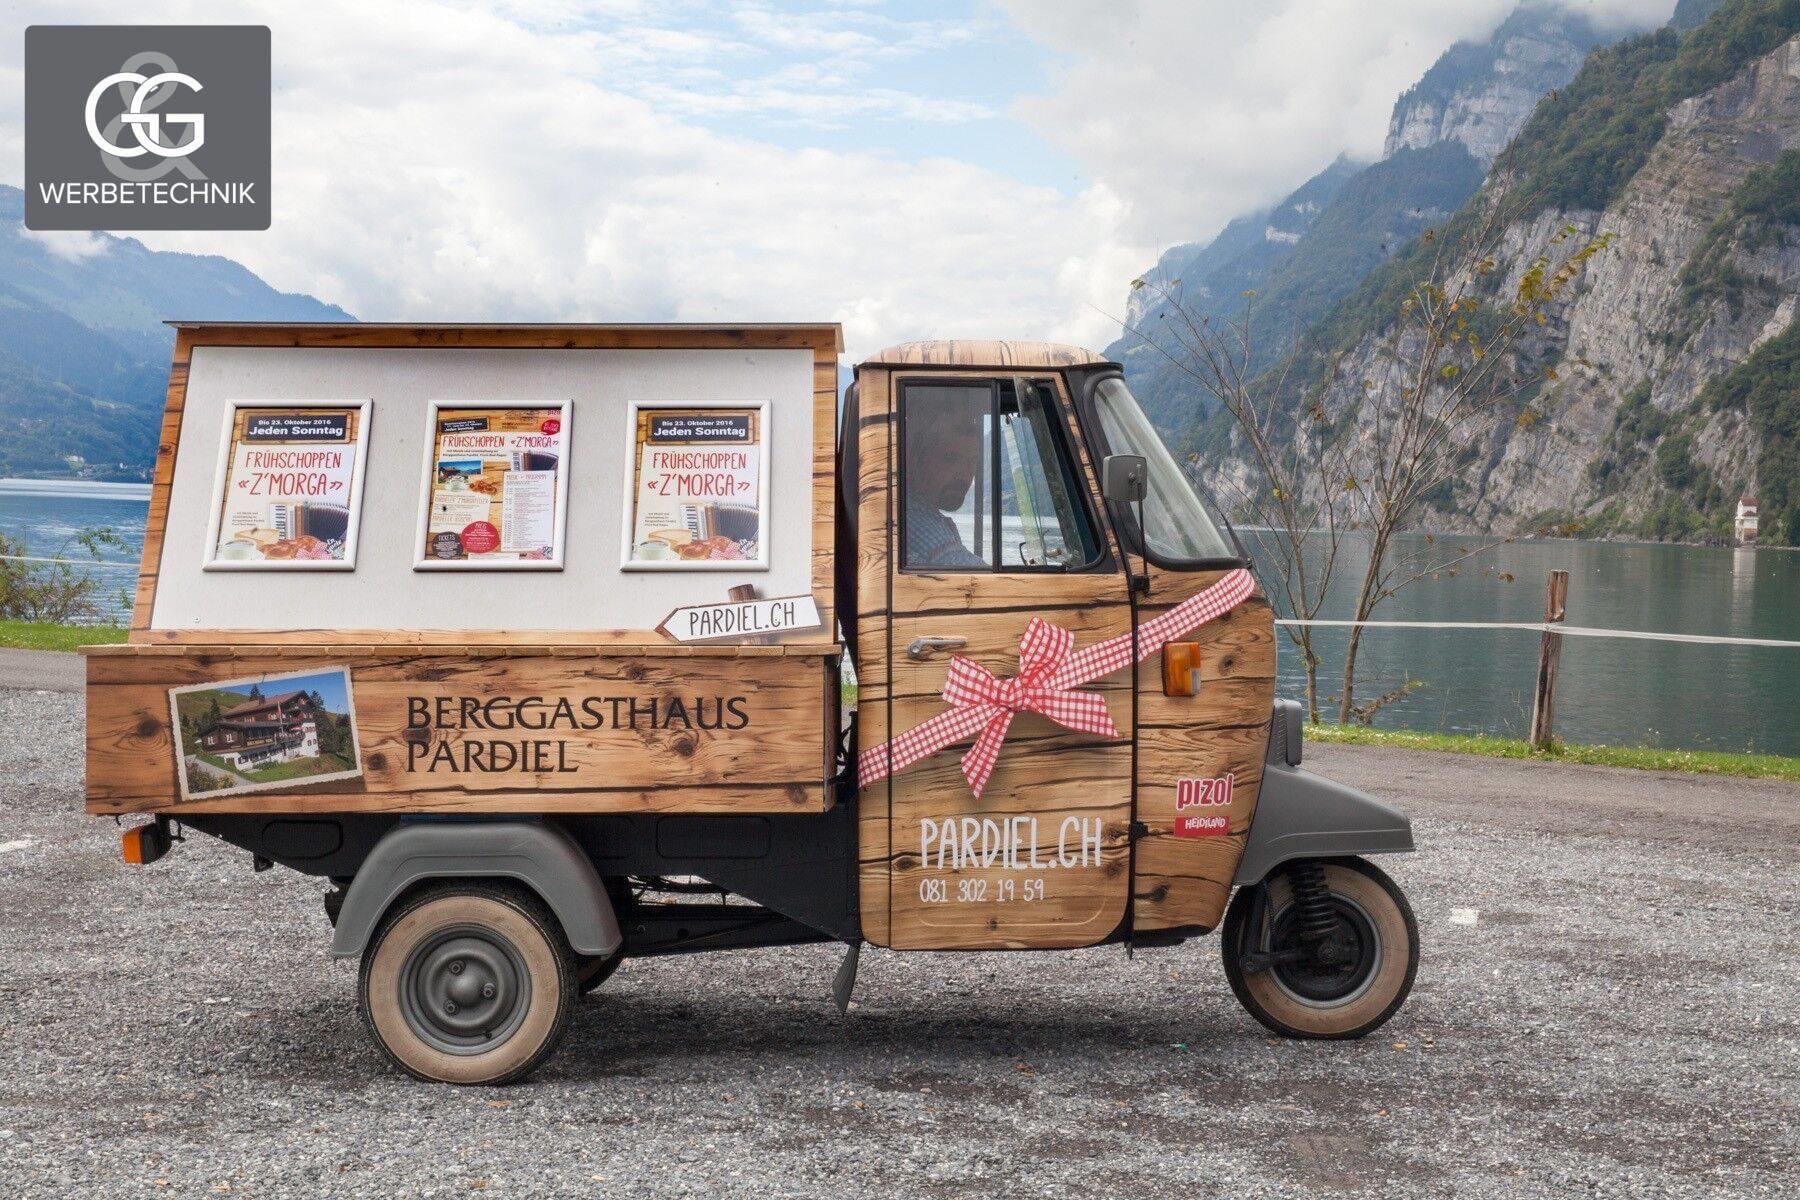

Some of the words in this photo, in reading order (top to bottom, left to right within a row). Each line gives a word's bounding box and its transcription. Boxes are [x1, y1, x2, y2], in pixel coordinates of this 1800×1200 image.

[249, 426, 288, 435] Jeden
[291, 426, 343, 437] Sonntag
[653, 427, 692, 436] Jeden
[695, 427, 746, 437] Sonntag
[245, 449, 341, 469] FRÜHSCHOPPEN
[652, 450, 747, 469] FRÜHSCHOPPEN
[689, 602, 795, 636] PARDIEL.CH
[406, 696, 750, 730] BERGGASTHAUS
[406, 740, 579, 773] PARDIEL
[1176, 773, 1234, 810] pizol
[920, 816, 1102, 870] PARDIEL.CH
[919, 879, 949, 902] 081
[957, 879, 987, 902] 302
[996, 879, 1015, 902] 19
[1023, 879, 1044, 902] 59
